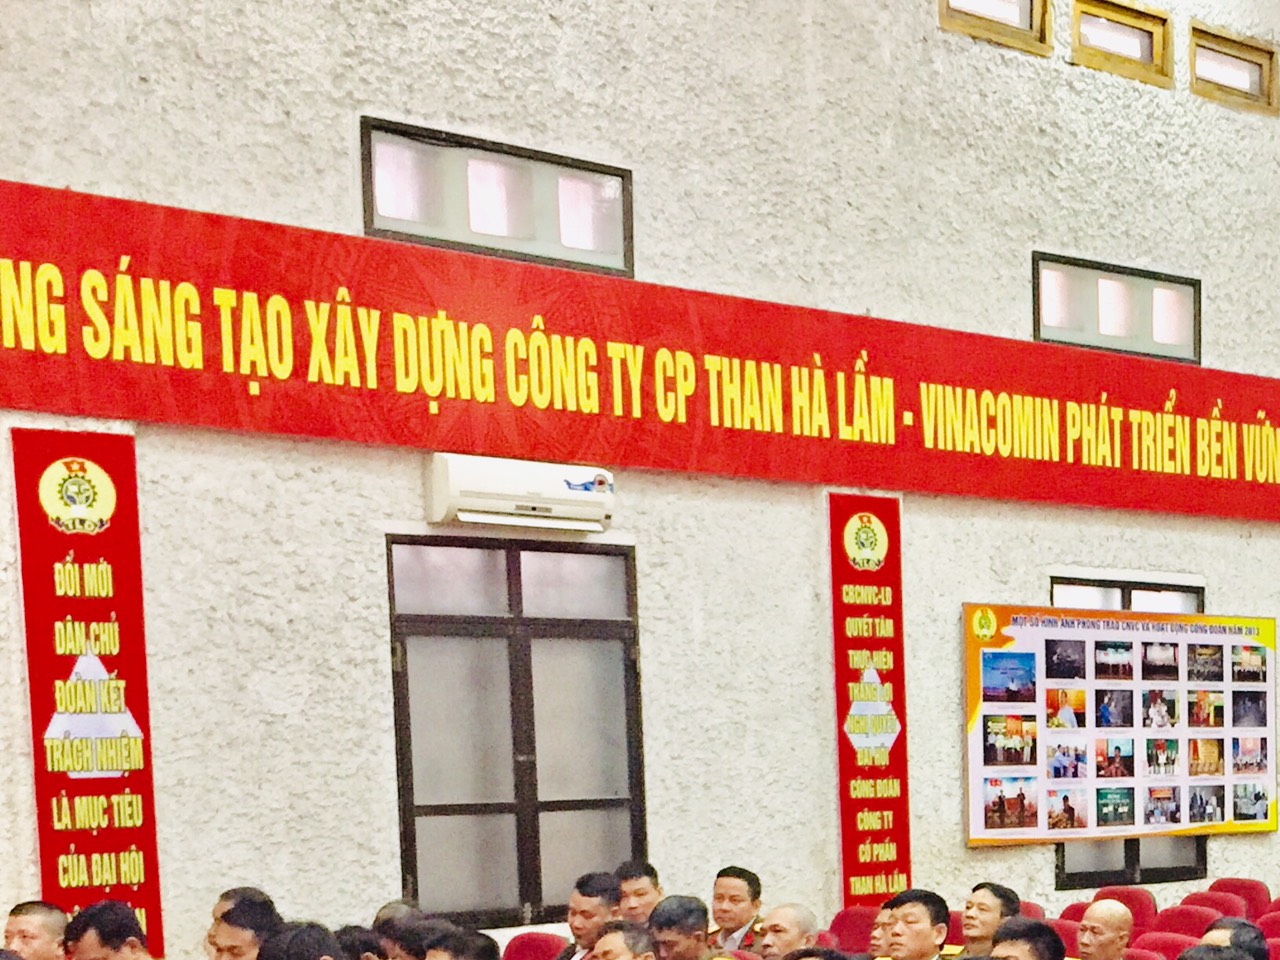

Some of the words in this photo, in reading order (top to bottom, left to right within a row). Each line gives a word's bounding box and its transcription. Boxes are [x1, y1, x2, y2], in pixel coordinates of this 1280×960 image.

[80, 255, 203, 370] SÁNG
[212, 287, 294, 396] TẠO
[304, 286, 381, 390] XÂY
[392, 310, 496, 414] DỰNG
[504, 315, 599, 415] CÔNG
[607, 340, 644, 419] TY
[654, 346, 696, 424] CP
[704, 354, 783, 434] THAN
[791, 352, 830, 438] HÀ
[836, 350, 895, 445] LẦM
[903, 411, 914, 426] -
[920, 381, 1060, 464] VINACOMIN
[1066, 392, 1123, 469] PHÁT
[1128, 388, 1191, 475] TRIỂN
[1196, 398, 1237, 480] BỀN
[54, 549, 80, 597] ĐỔI
[83, 556, 113, 598] MỚI
[54, 614, 87, 656] DÂN
[89, 610, 120, 656] CHỦ
[54, 671, 97, 714] ĐOÀN
[98, 668, 126, 714] KẾT
[44, 730, 93, 772] TRÁCH
[95, 730, 144, 778] NHIỆM
[52, 789, 72, 830] LÀ
[74, 795, 109, 836] MỤC
[111, 787, 143, 828] TIÊU
[58, 843, 89, 888] CỦA
[119, 843, 145, 891] HỘI
